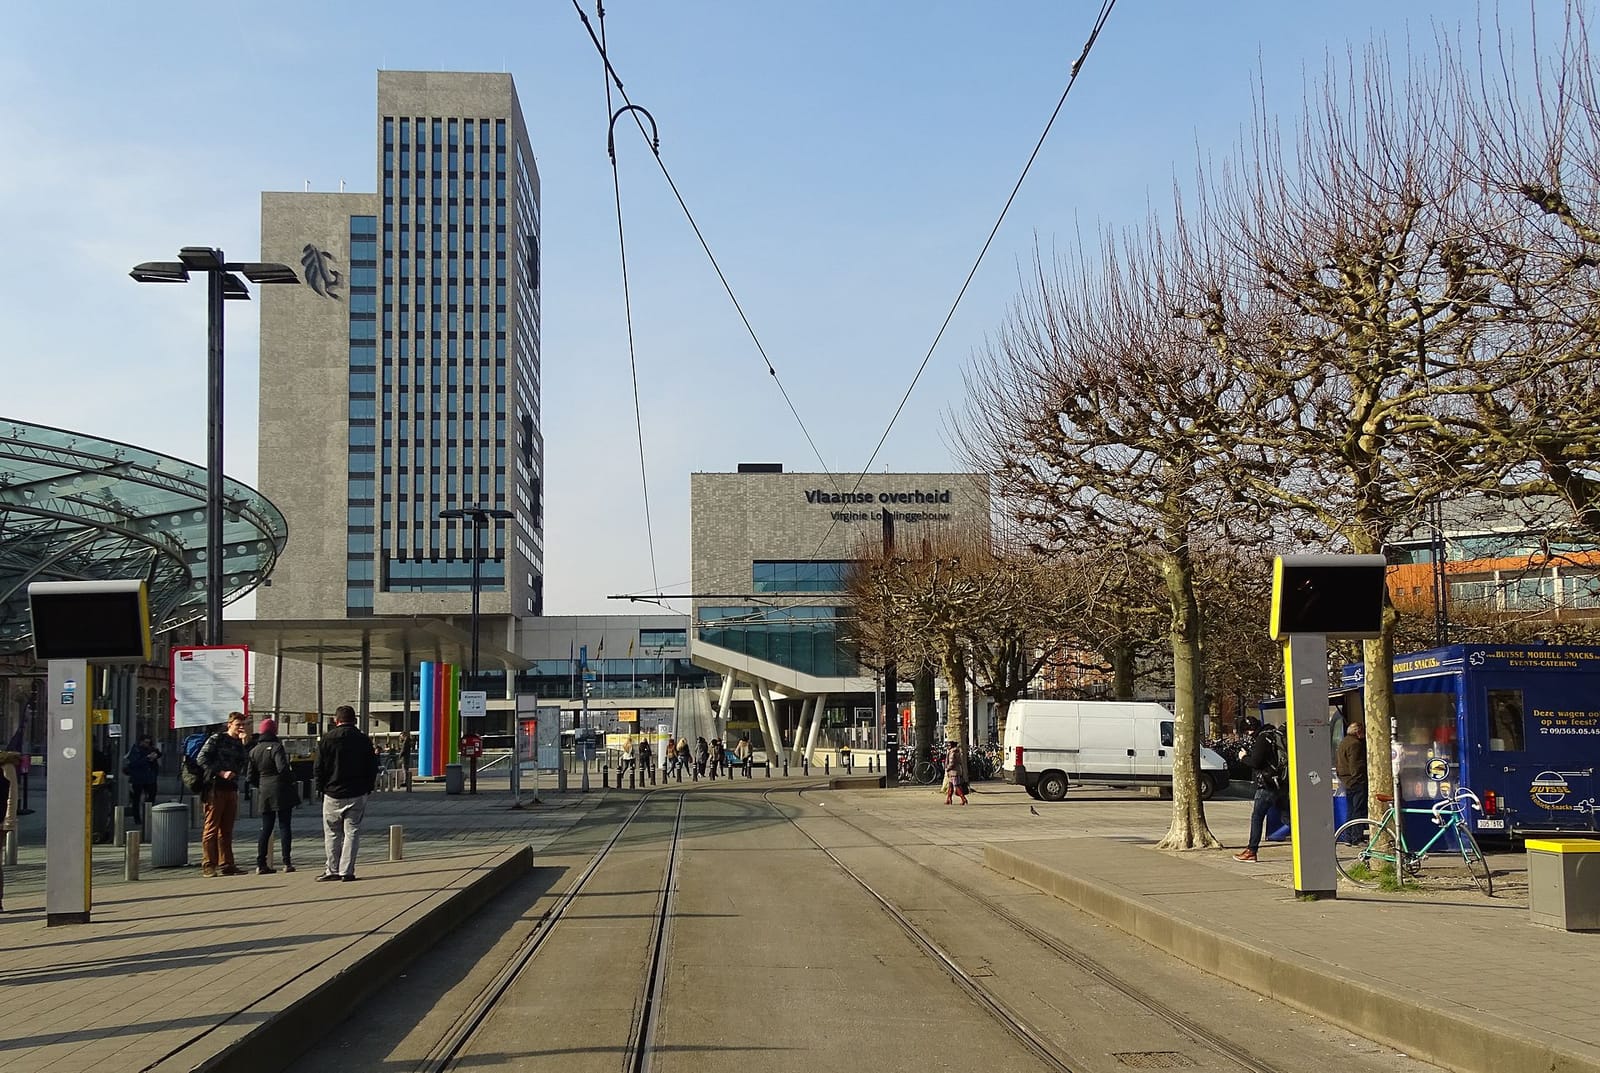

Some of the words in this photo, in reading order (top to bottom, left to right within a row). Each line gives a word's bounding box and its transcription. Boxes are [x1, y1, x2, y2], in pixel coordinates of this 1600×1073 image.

[805, 489, 874, 504] Vlaamse
[878, 489, 951, 504] overheid
[831, 511, 868, 523] Virginie
[1533, 709, 1555, 717] Deze
[1557, 711, 1585, 719] wagen
